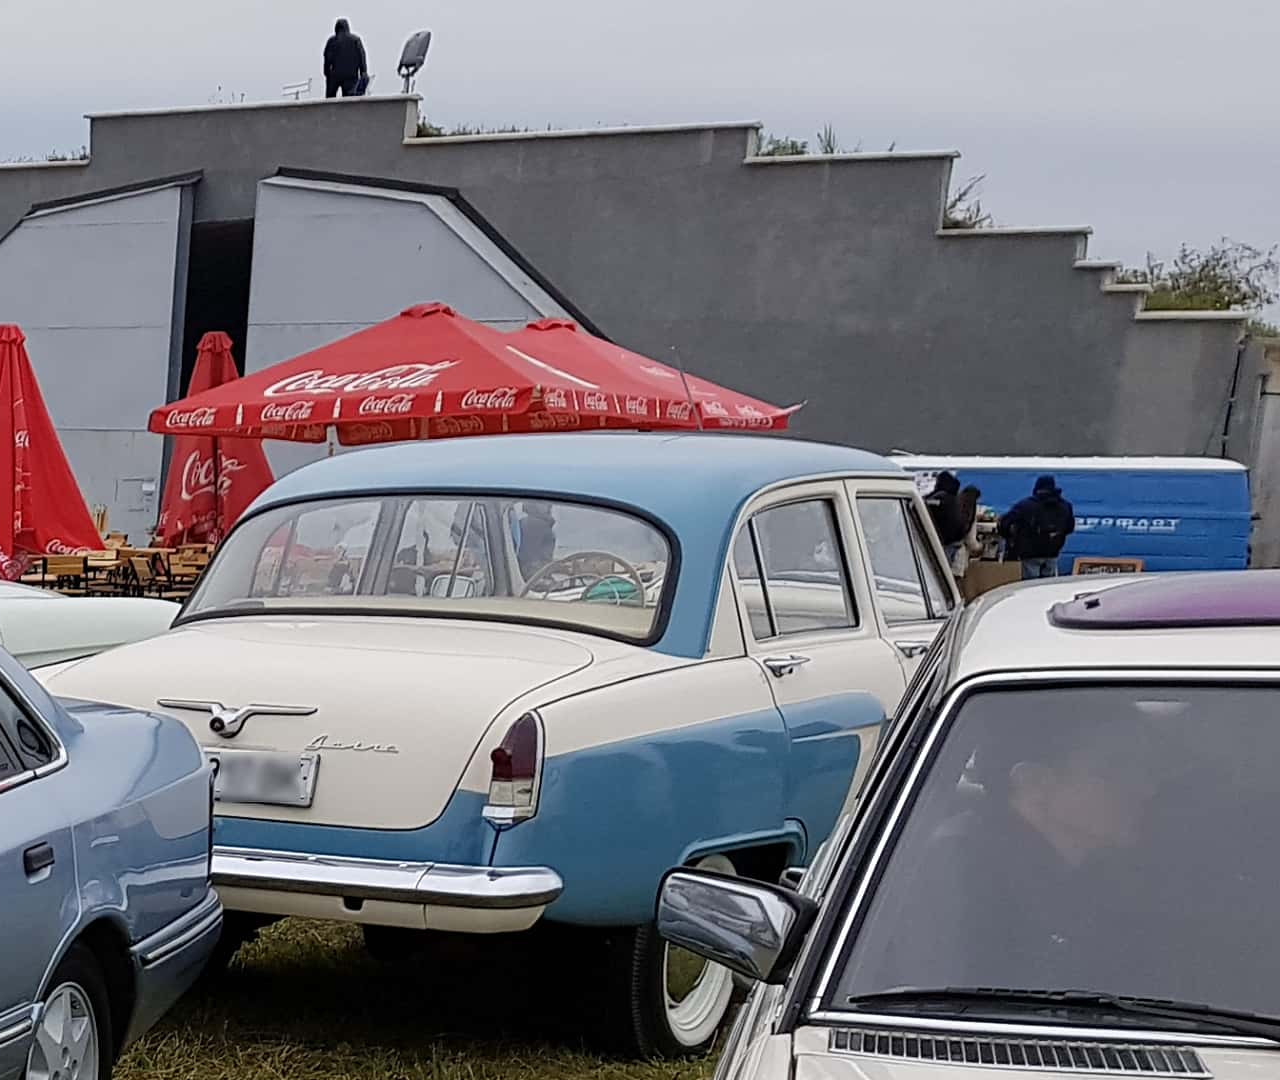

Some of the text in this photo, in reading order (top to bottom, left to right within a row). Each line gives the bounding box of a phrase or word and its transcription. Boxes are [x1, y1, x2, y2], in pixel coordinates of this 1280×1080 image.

[263, 359, 462, 397] Coca-Cola
[359, 393, 417, 415] Coca-Cola
[461, 387, 519, 409] Coca-Cola
[166, 407, 217, 428] Coca-Cola
[261, 400, 315, 422] Coca-Cola
